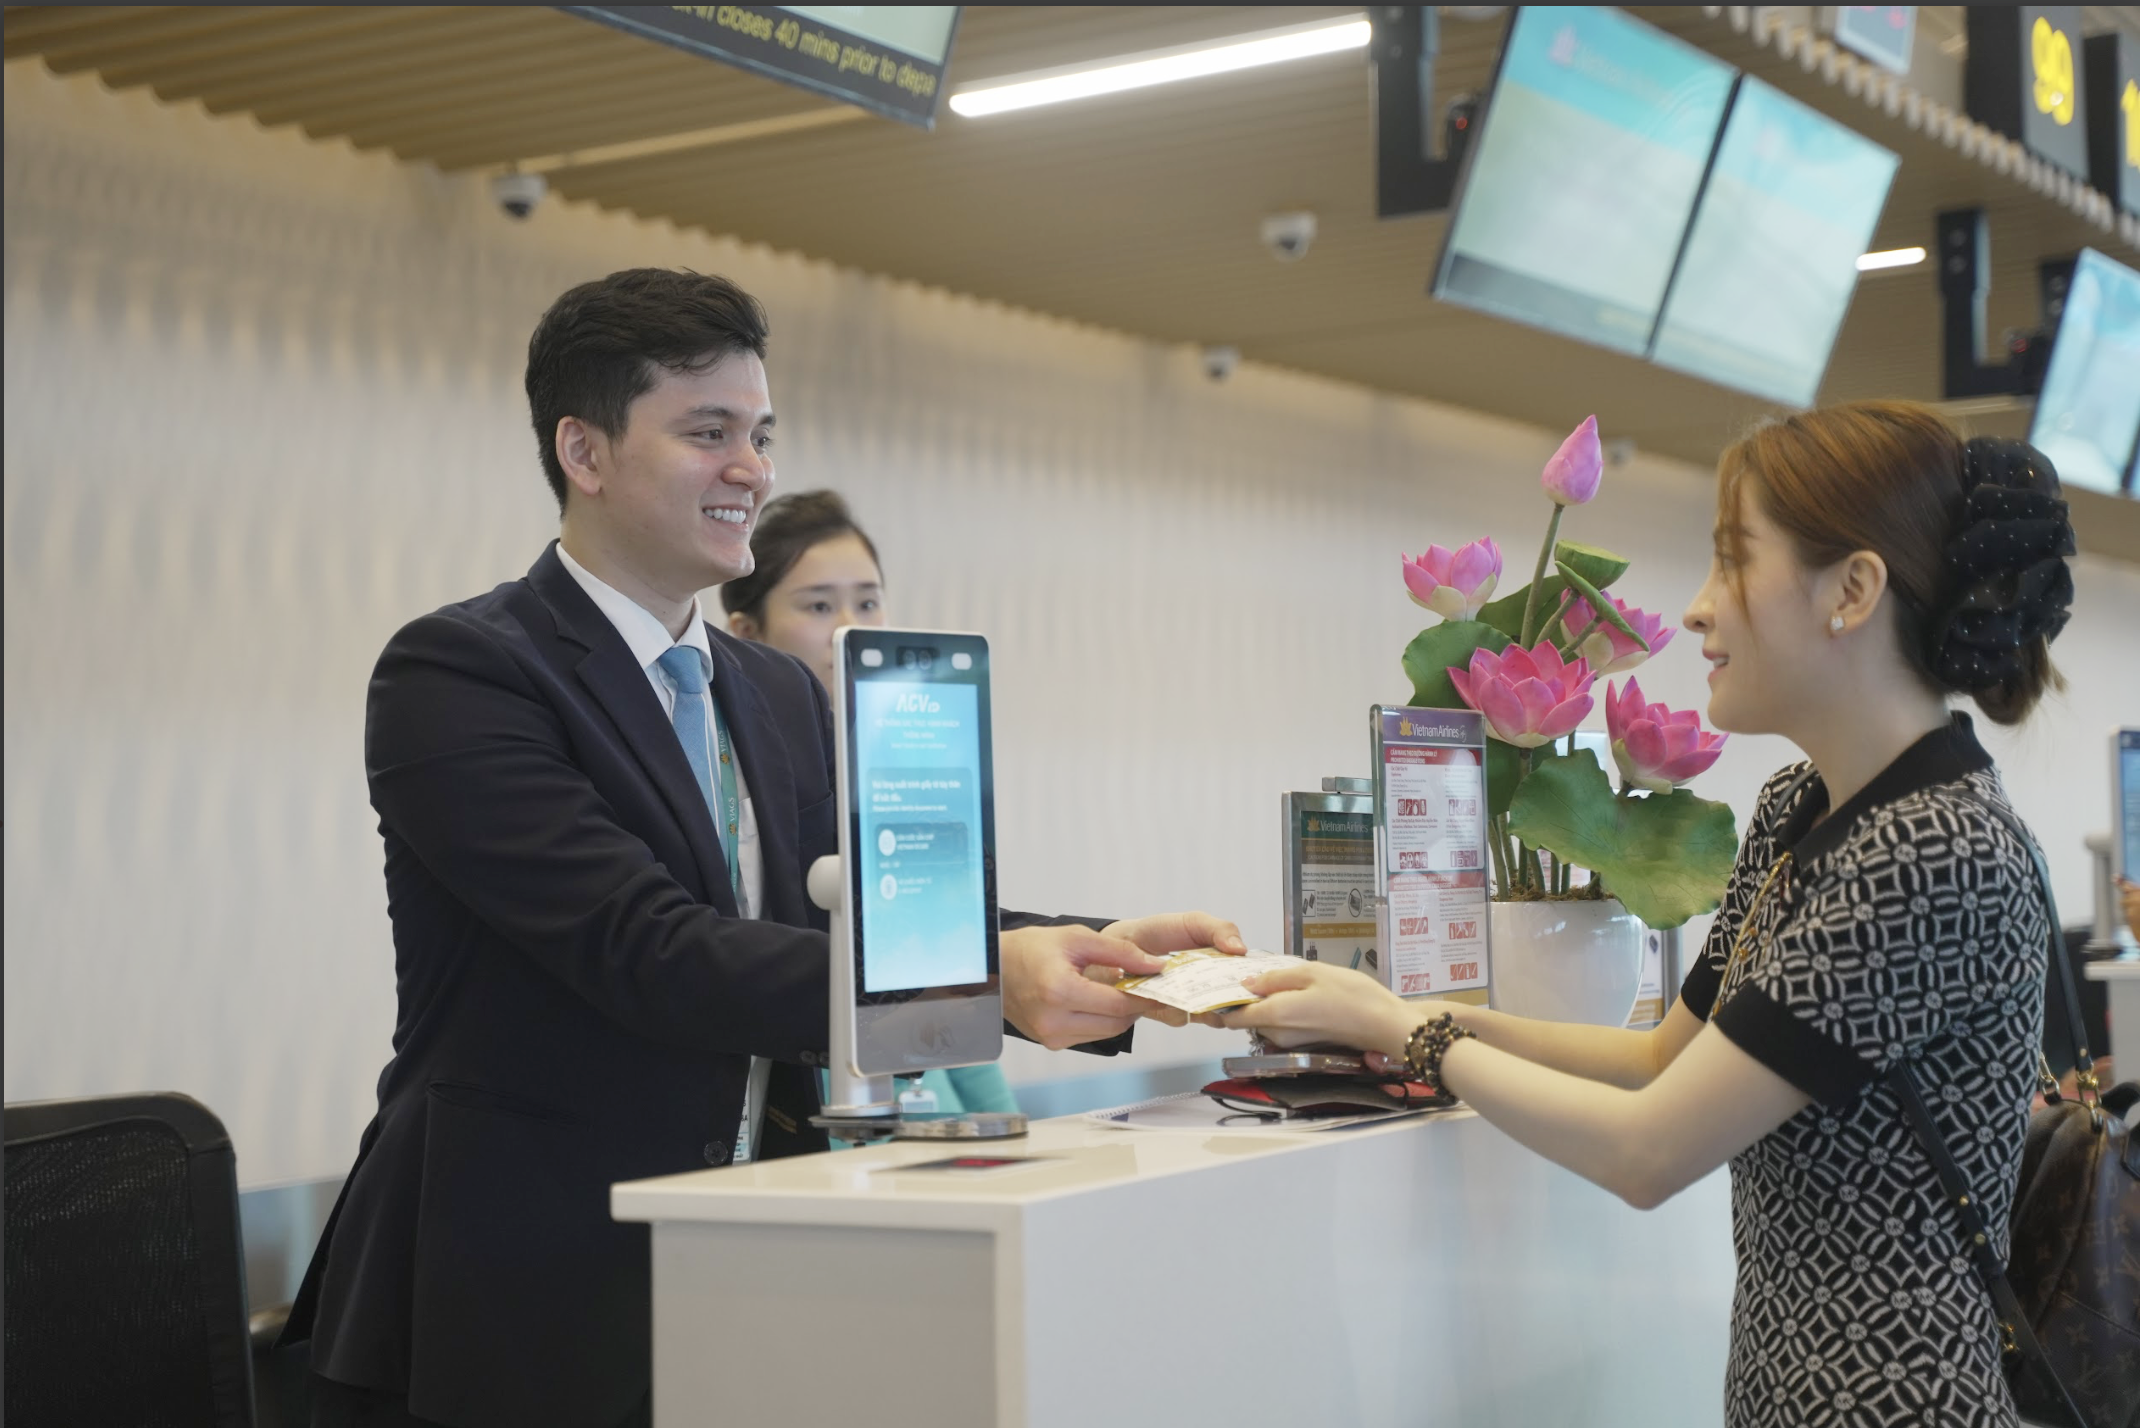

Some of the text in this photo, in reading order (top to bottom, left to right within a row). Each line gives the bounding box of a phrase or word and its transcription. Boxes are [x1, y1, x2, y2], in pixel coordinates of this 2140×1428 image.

[774, 18, 800, 50] 40
[798, 30, 840, 65] mins
[838, 45, 880, 77] prior
[878, 54, 897, 84] to
[1320, 820, 1346, 833] Vietnam
